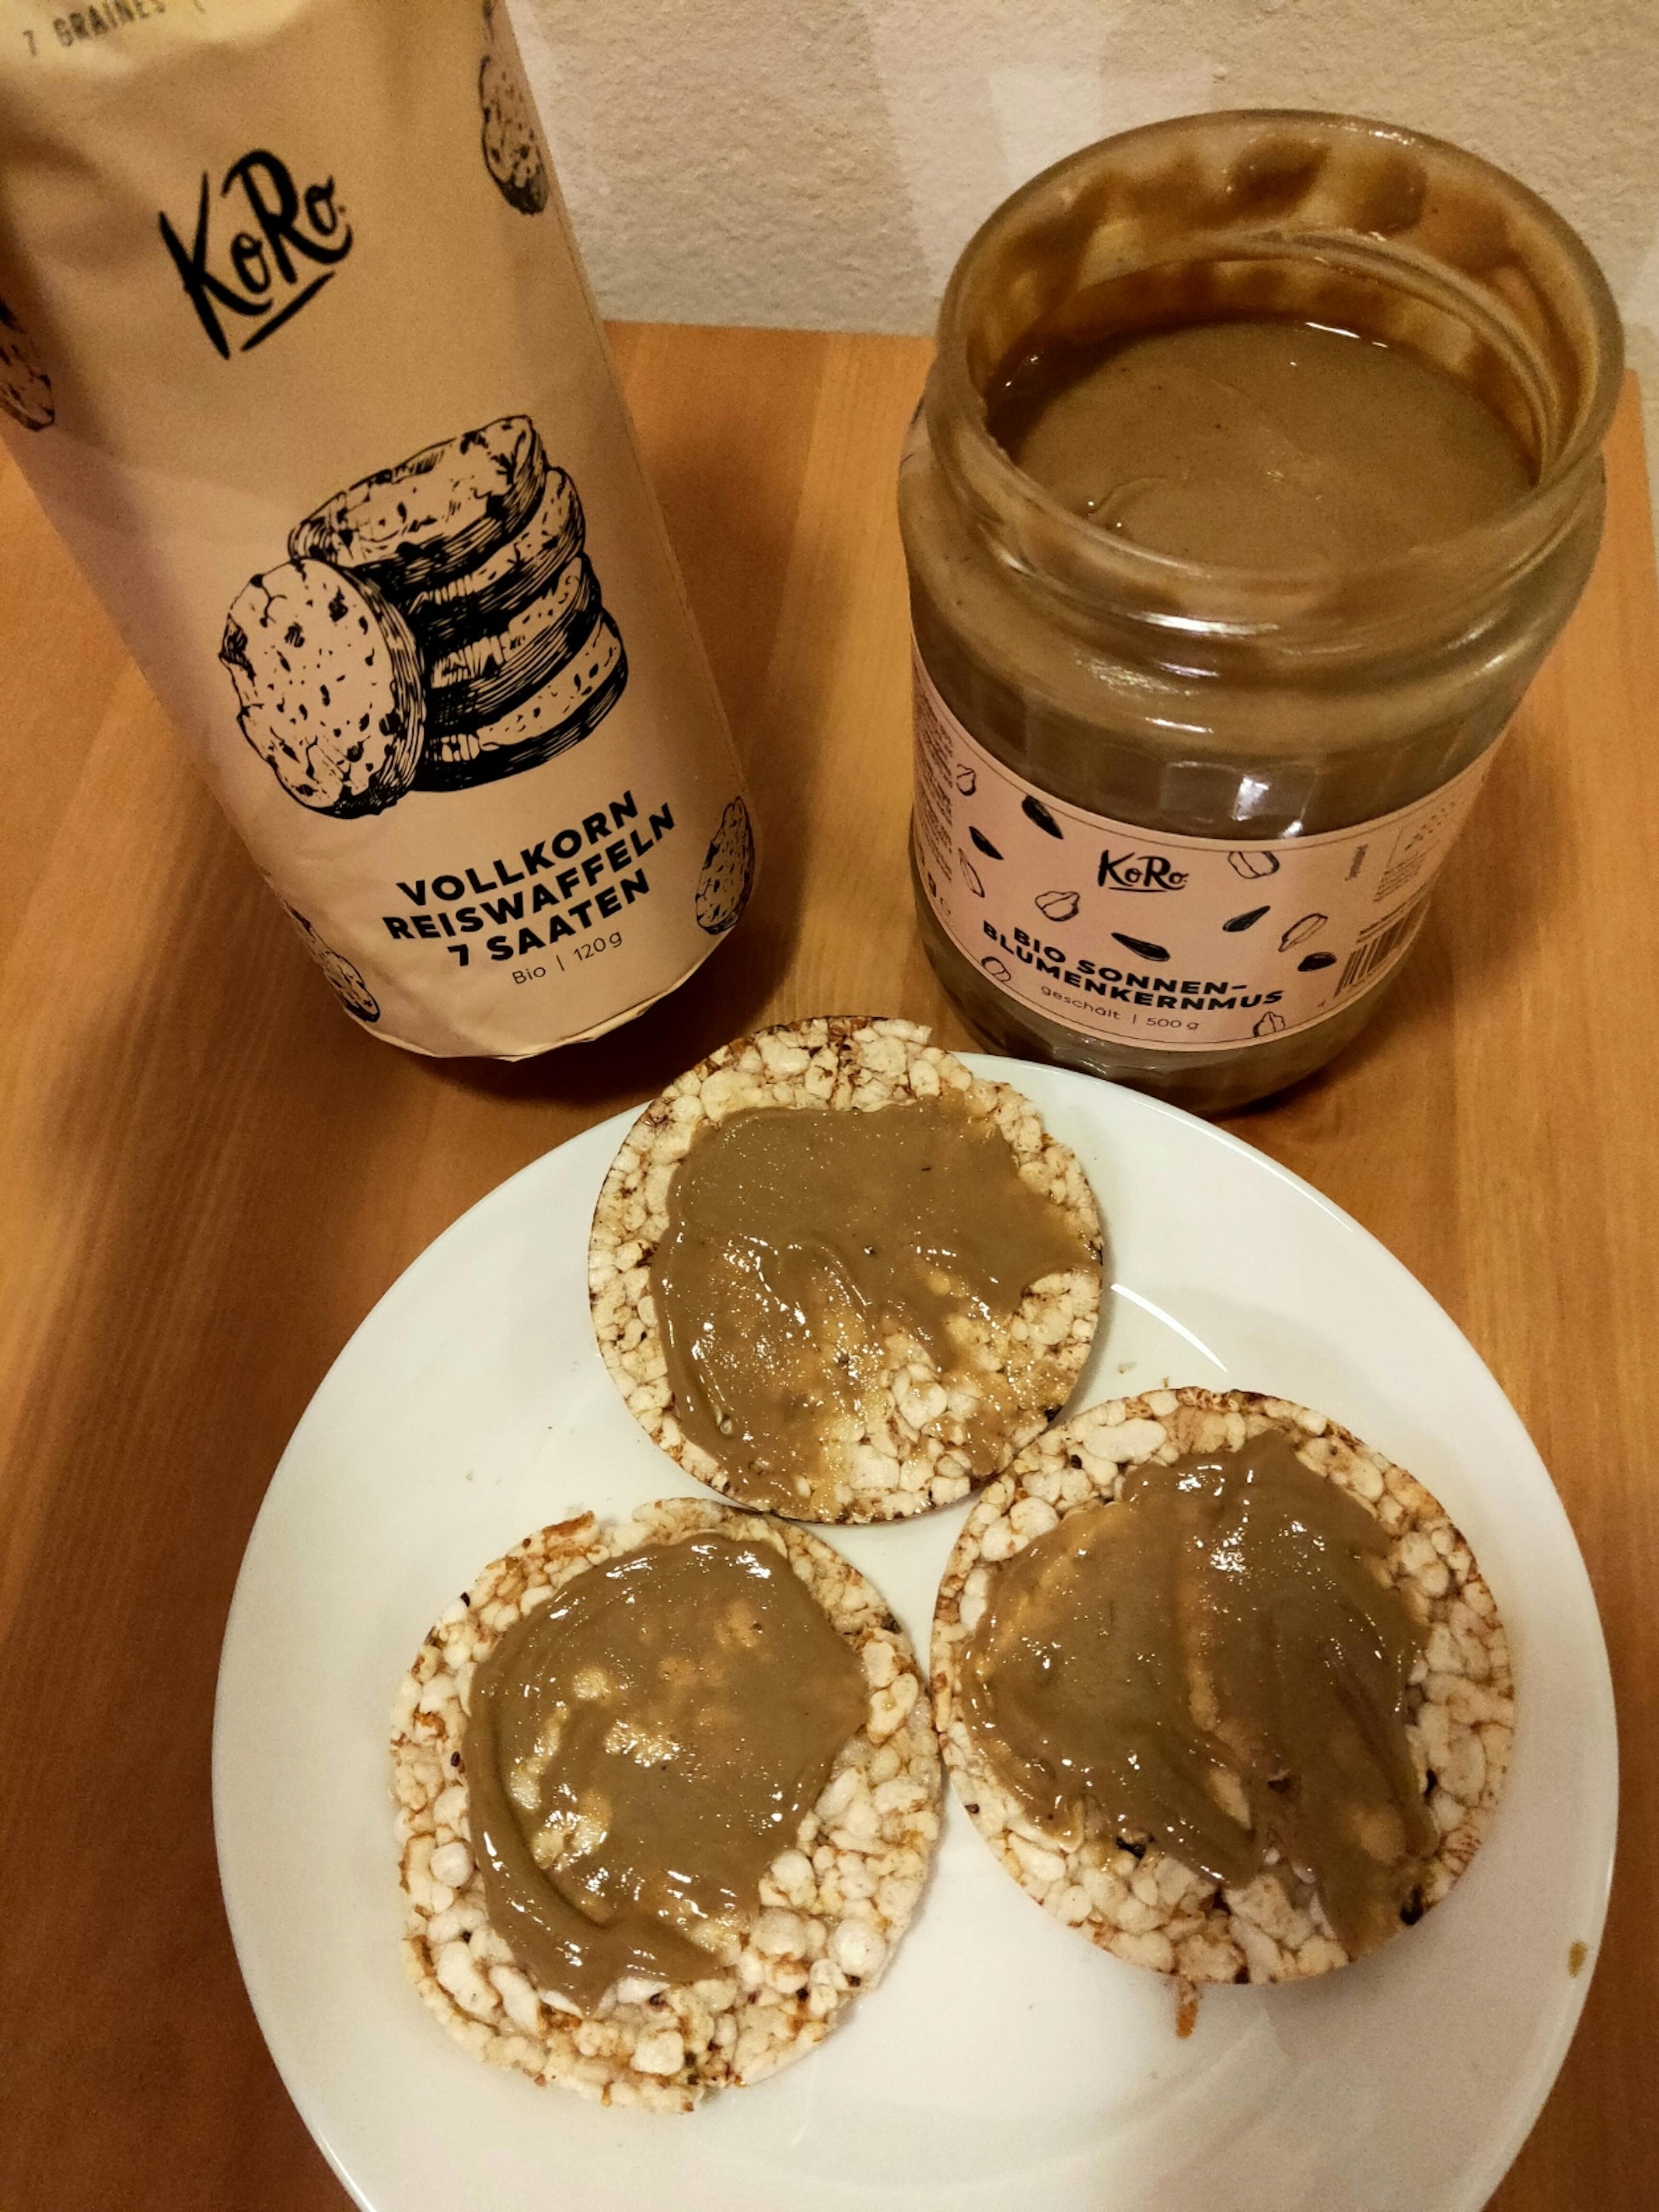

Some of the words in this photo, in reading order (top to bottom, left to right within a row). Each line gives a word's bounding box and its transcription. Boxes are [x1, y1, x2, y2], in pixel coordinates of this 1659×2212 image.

[158, 148, 353, 360] KoRo
[382, 803, 676, 940] REISWAFFELN
[396, 790, 639, 906] VOLLKORN
[1097, 849, 1190, 892] KoRo
[447, 944, 469, 967] 7
[486, 869, 650, 961] SAATEN
[1014, 927, 1066, 963] BIO
[1077, 959, 1248, 995] SONNEN-
[512, 966, 546, 984] Bio
[983, 920, 1284, 1011] BLUMENKERNMUS
[1040, 985, 1121, 1021] geschält
[1146, 1016, 1182, 1029] 500
[1188, 1022, 1199, 1031] g
